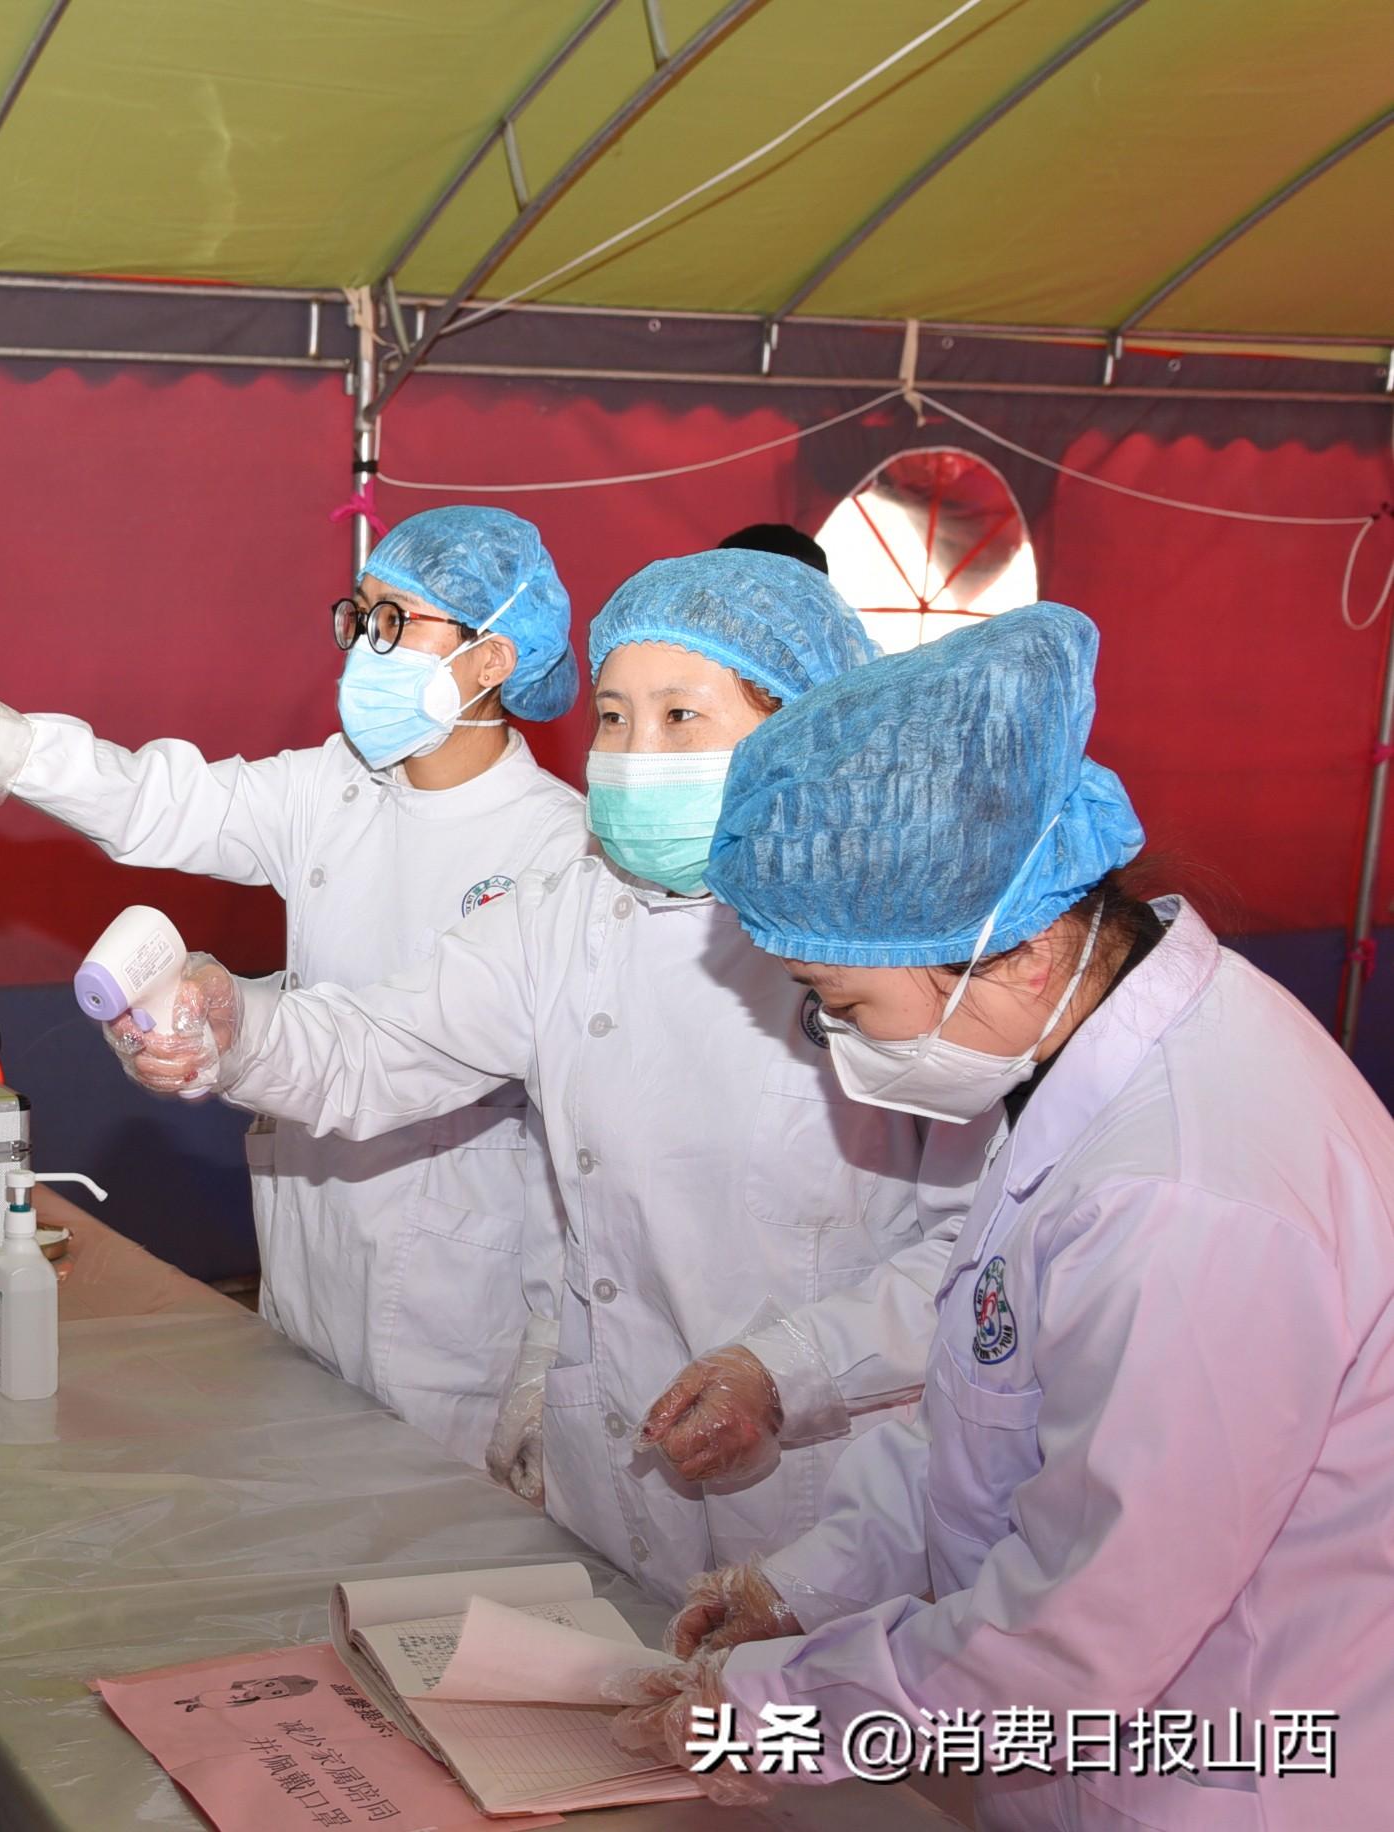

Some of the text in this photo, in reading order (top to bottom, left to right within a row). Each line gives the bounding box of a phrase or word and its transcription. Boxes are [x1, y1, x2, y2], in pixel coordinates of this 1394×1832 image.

[245, 1736, 352, 1828] 并佩戴口罩
[275, 1720, 401, 1821] 减少家属陪同
